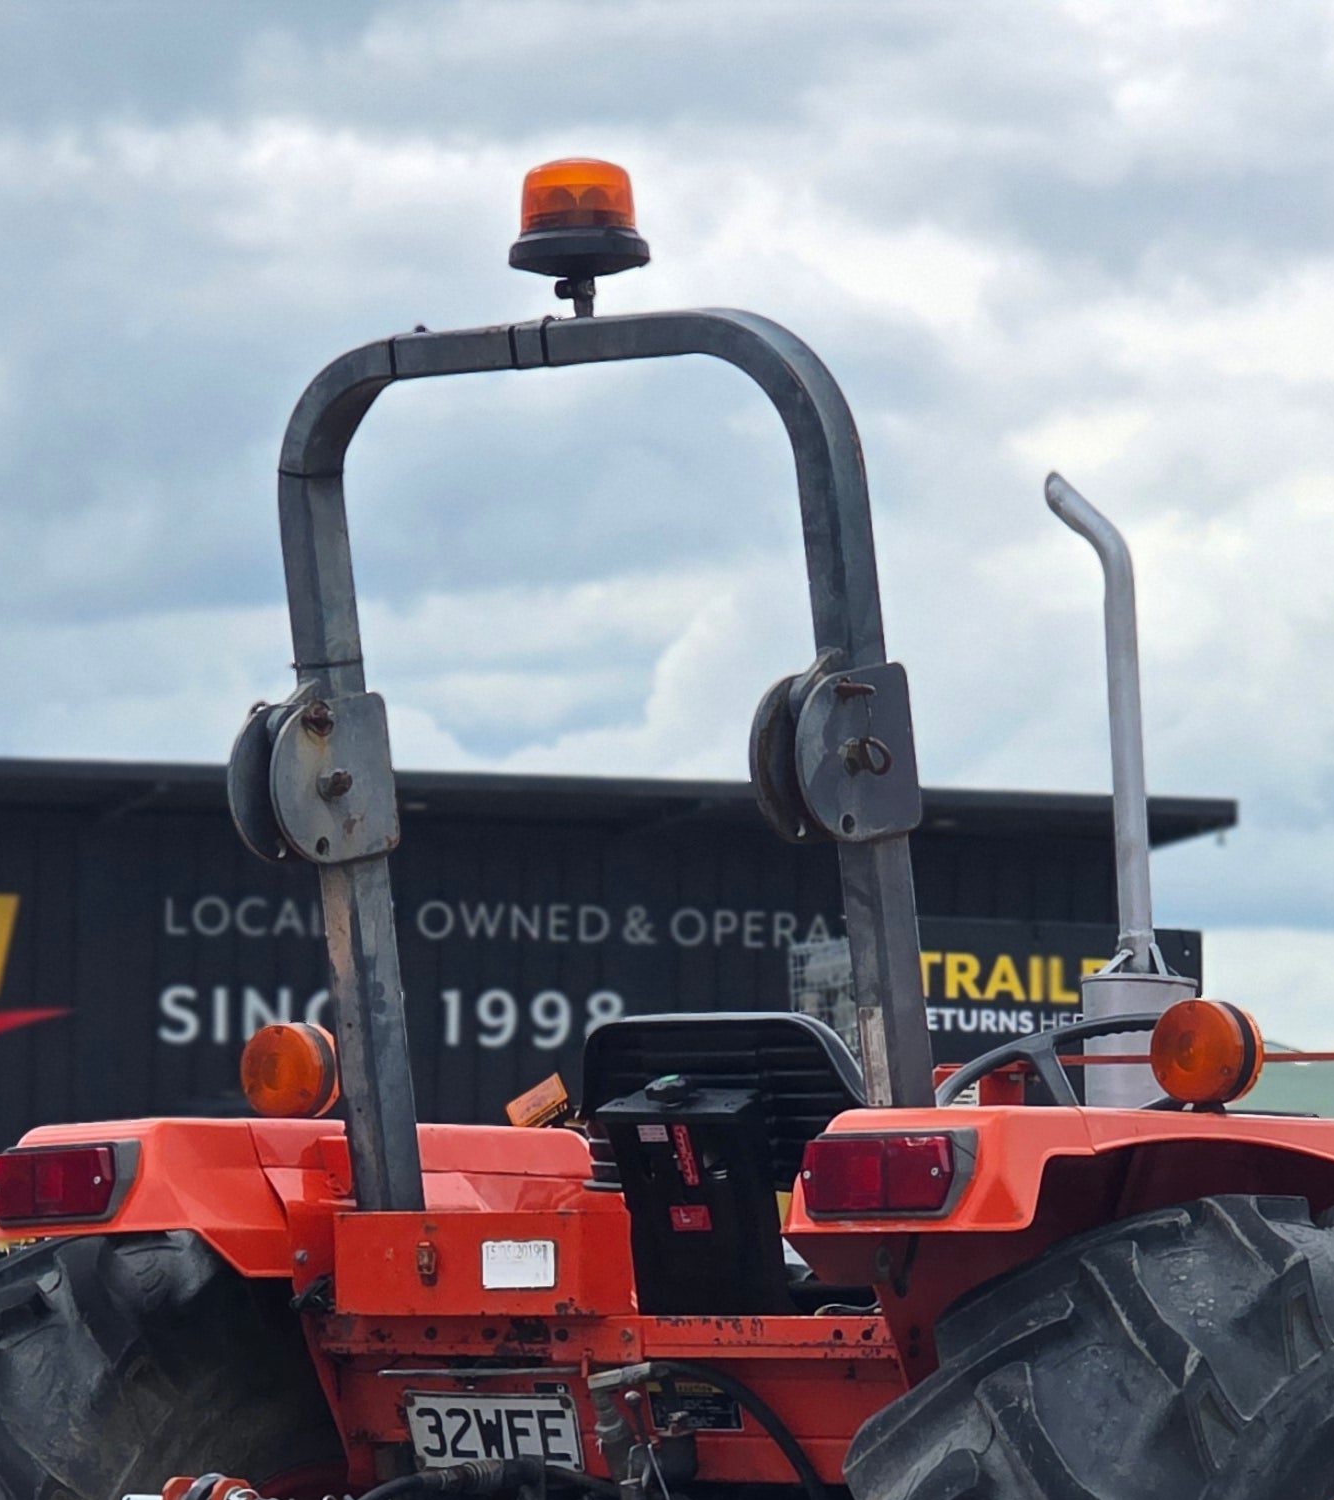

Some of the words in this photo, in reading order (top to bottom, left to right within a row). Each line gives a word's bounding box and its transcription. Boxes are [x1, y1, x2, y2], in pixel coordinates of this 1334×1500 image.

[165, 896, 321, 937] LOCA
[417, 901, 611, 943] OWNED
[622, 904, 658, 945] &
[670, 908, 832, 948] OPERA
[920, 952, 1111, 1003] TRAIL
[158, 984, 329, 1044] SIN
[442, 988, 625, 1048] 1998
[926, 1007, 1035, 1034] ETURNS
[415, 1407, 573, 1462] 32WFE
